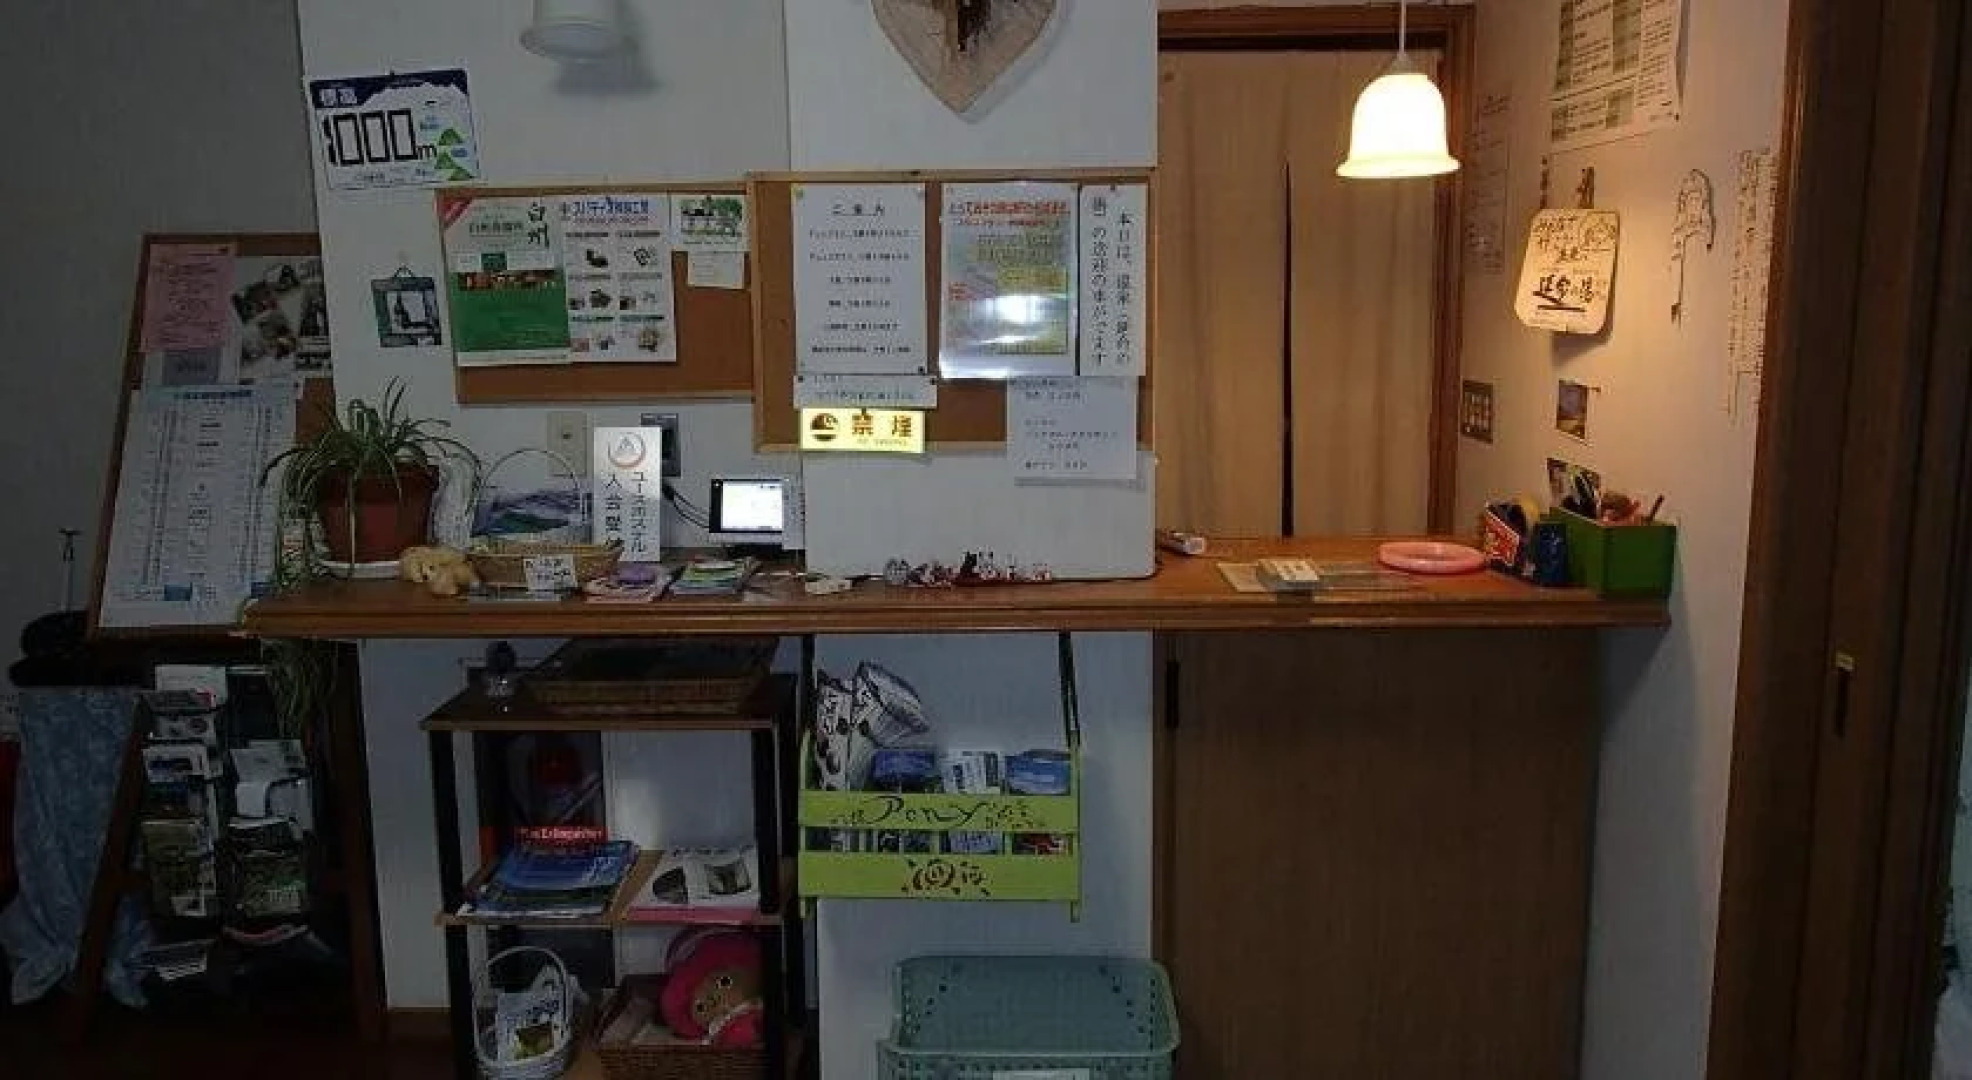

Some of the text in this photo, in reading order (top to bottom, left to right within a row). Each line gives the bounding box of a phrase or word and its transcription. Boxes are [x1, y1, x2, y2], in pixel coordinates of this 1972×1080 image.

[528, 202, 550, 248] 白州
[852, 413, 912, 437] 禁煙
[631, 471, 648, 553] ユースホステル
